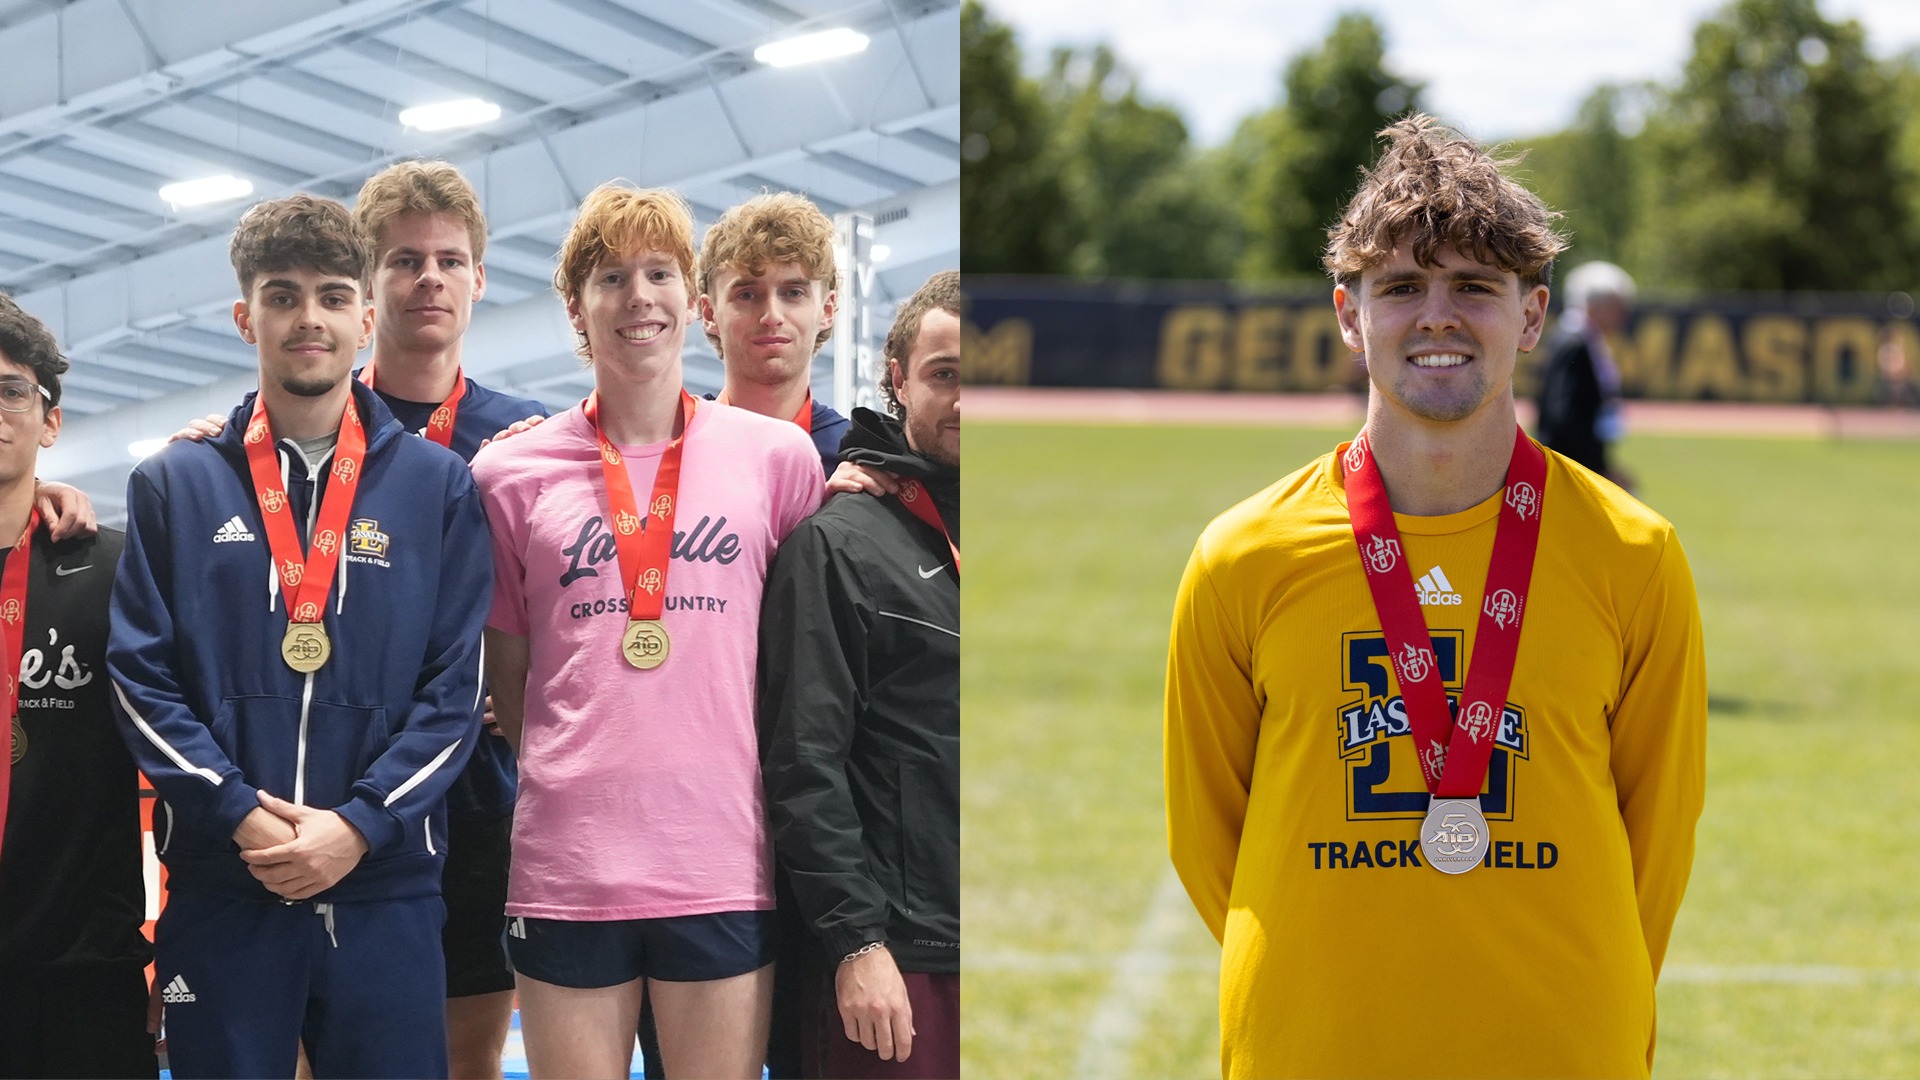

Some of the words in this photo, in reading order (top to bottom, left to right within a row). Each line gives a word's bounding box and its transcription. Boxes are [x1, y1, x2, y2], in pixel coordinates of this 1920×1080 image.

[1506, 481, 1536, 516] 50
[1534, 489, 1542, 521] ANNIVERSARY
[213, 531, 255, 543] adidas
[560, 515, 742, 588] Laalle
[1359, 543, 1372, 576] ANNIVERSARY
[1366, 539, 1401, 573] 50
[571, 598, 629, 619] CROSS
[665, 596, 728, 613] UNTRY
[1417, 590, 1462, 606] didas
[1483, 588, 1517, 624] 50
[1514, 595, 1524, 628] ANNIVERSARY
[1391, 652, 1404, 685] ANNIVERSARY
[1399, 648, 1434, 683] 50
[18, 699, 41, 709] RACK
[41, 697, 49, 708] &
[49, 697, 75, 709] FIELD
[1457, 701, 1492, 738] 50
[1345, 699, 1520, 748] LASE
[1488, 707, 1500, 742] ANNIVERSARY
[1419, 749, 1432, 783] ANNIVERSARY
[1436, 812, 1480, 857] 50
[1308, 840, 1423, 869] TRACK
[1484, 841, 1559, 869] IELD
